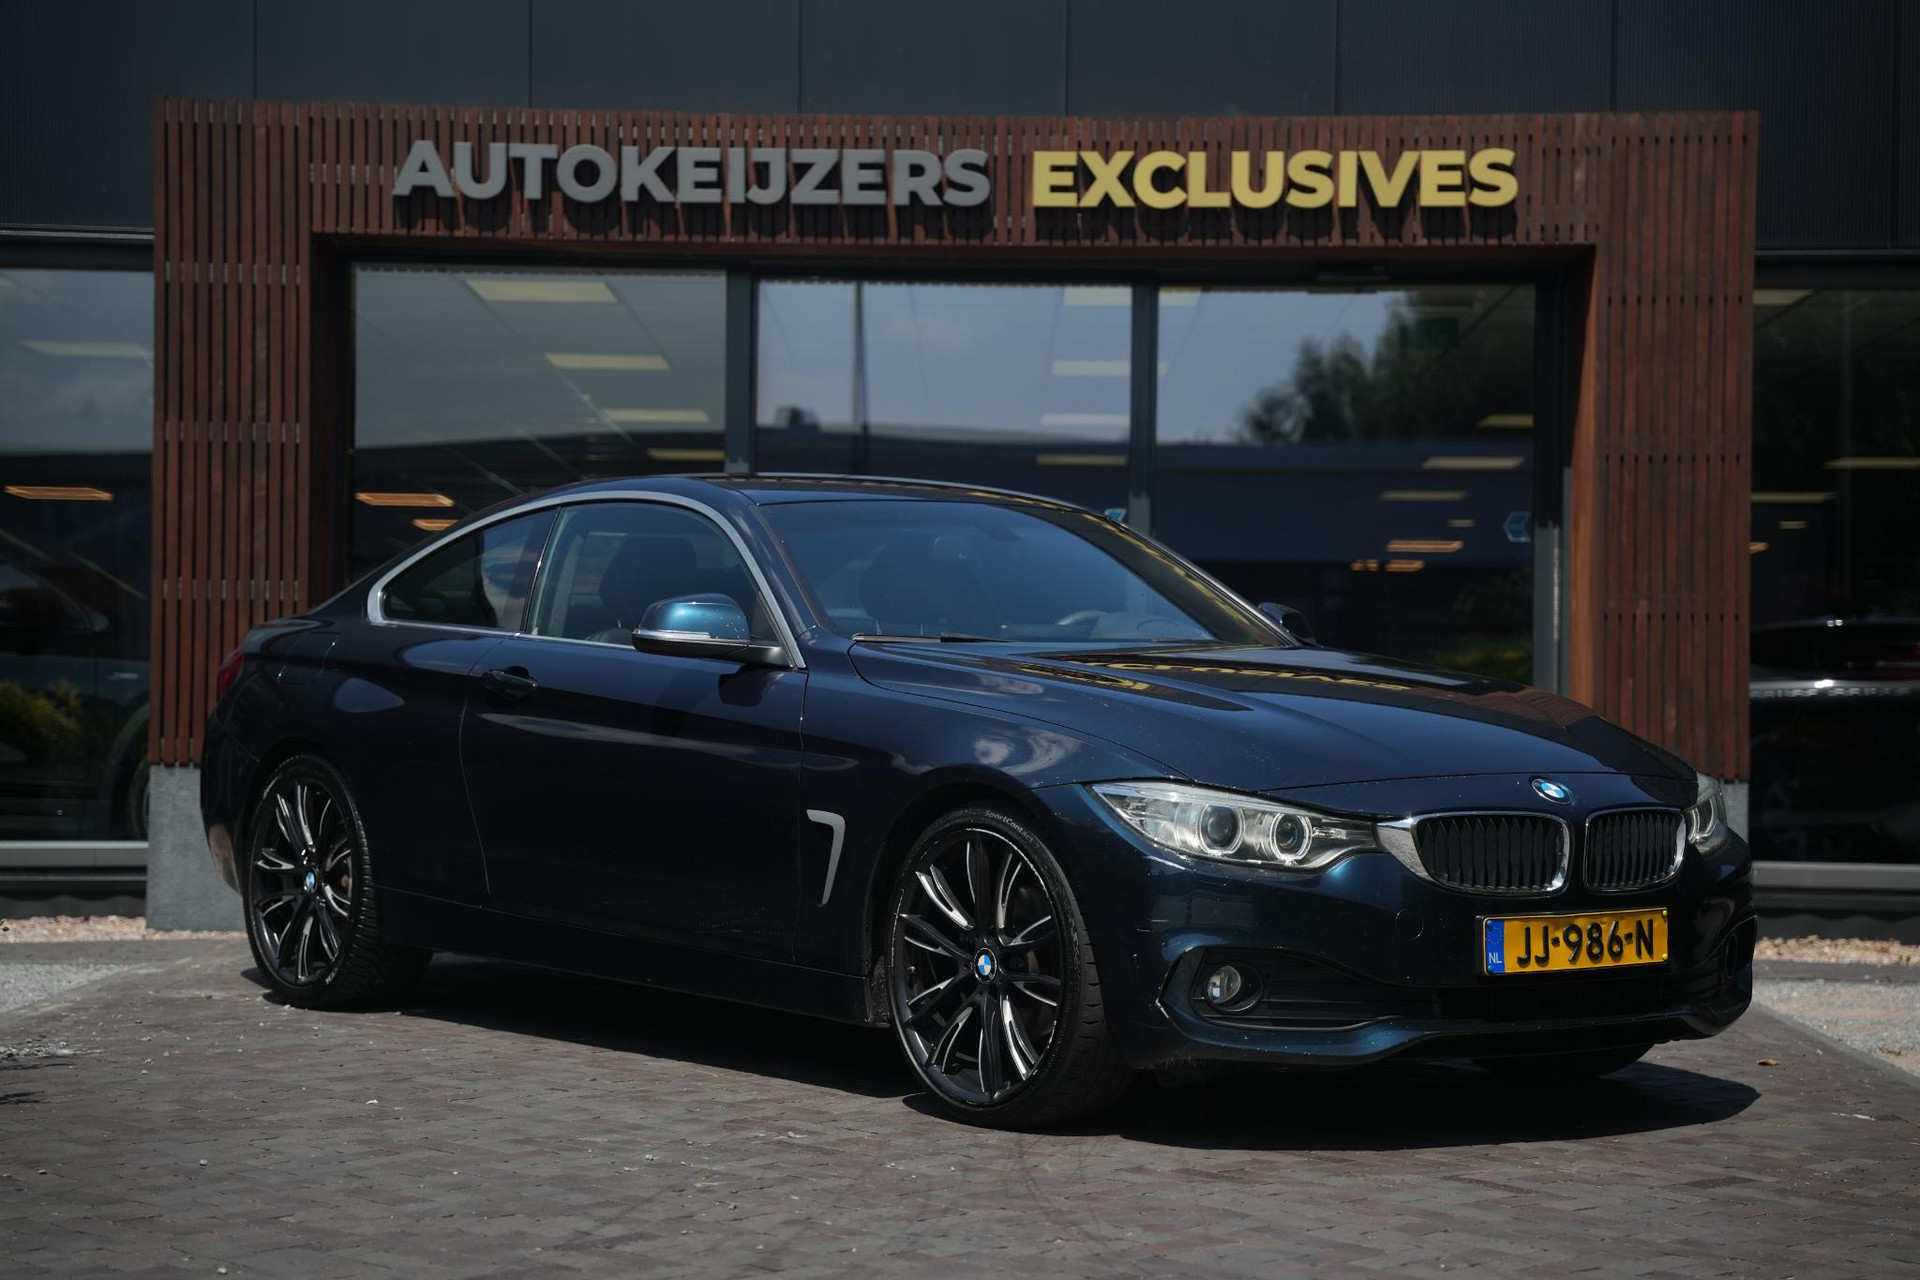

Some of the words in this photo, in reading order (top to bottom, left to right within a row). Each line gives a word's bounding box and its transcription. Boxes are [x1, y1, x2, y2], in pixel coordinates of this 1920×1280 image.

[392, 139, 991, 207] AUTOKEIJZERS
[1032, 147, 1519, 209] EXCLUSIVES
[984, 809, 1037, 844] SportContact
[1488, 952, 1503, 964] NL
[1516, 918, 1655, 968] JJ-986-N
